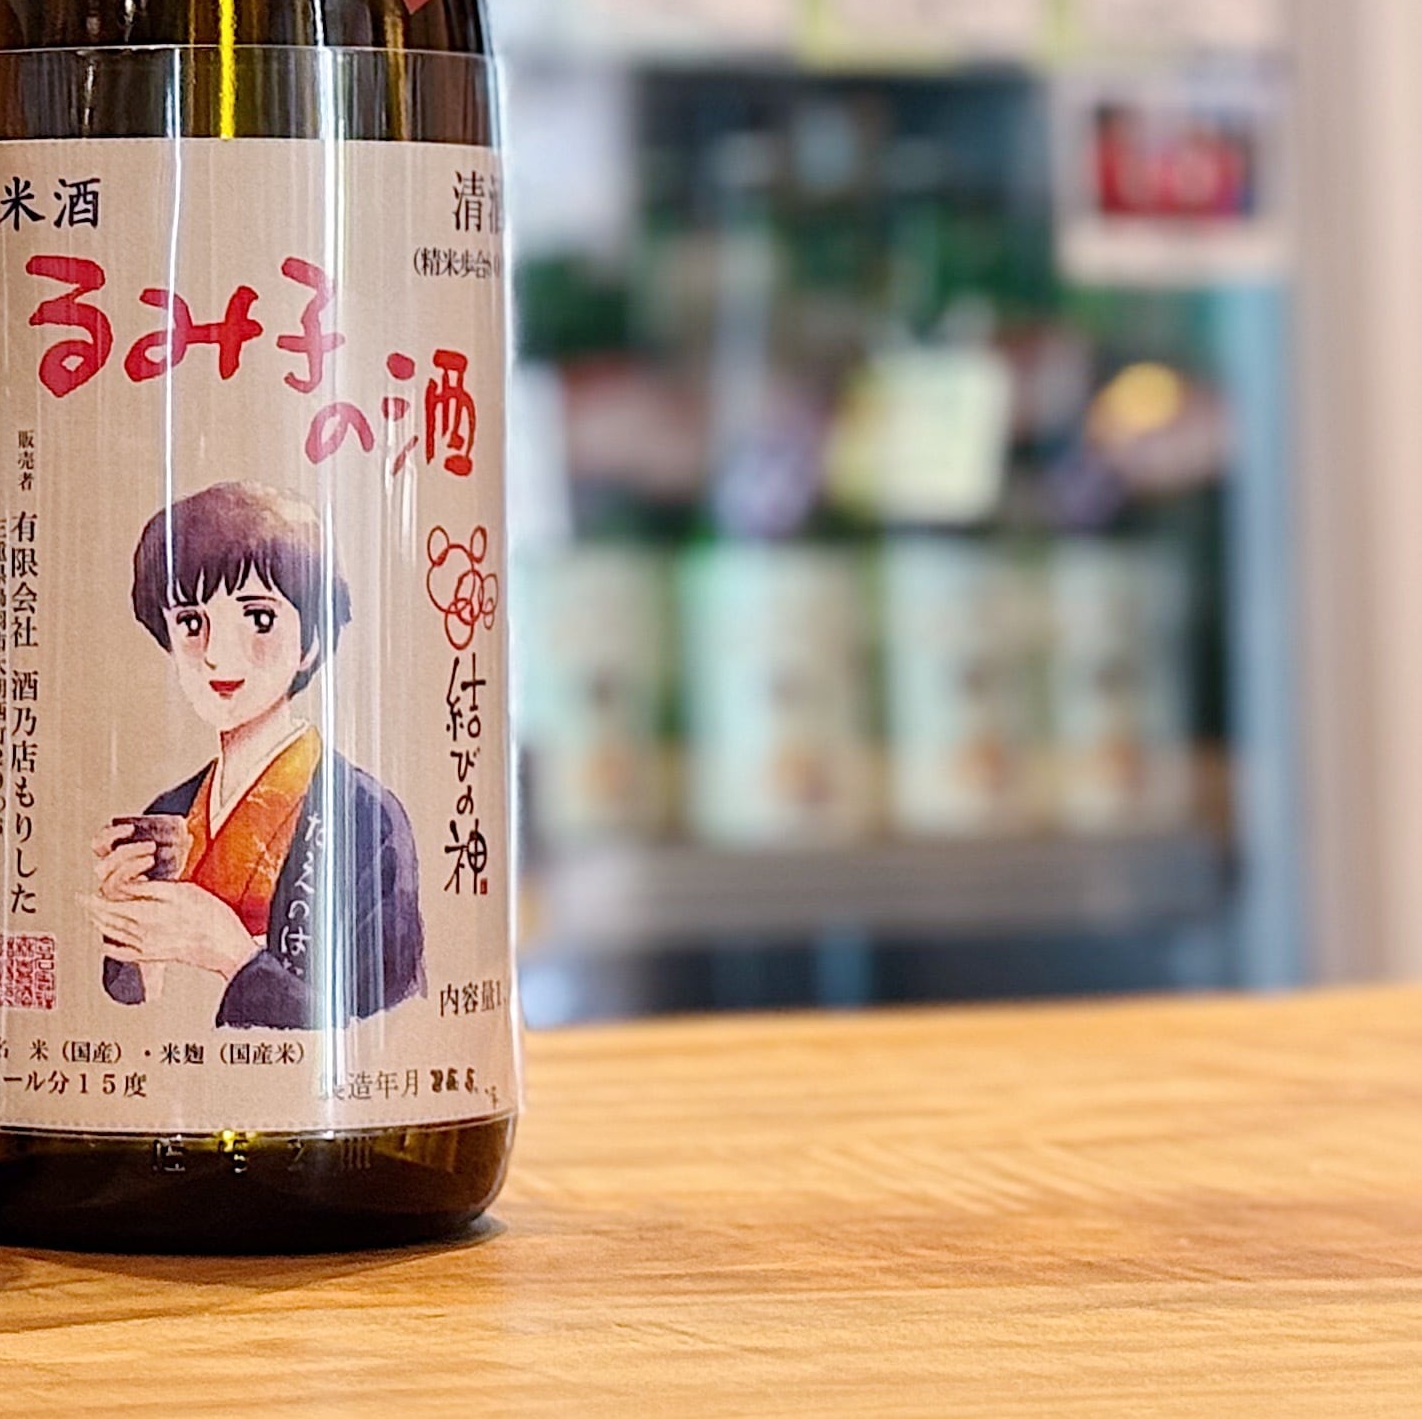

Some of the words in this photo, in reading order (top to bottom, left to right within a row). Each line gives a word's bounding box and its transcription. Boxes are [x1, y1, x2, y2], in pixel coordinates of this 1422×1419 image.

[18, 430, 35, 492] 販売者
[444, 652, 487, 896] 結びの神
